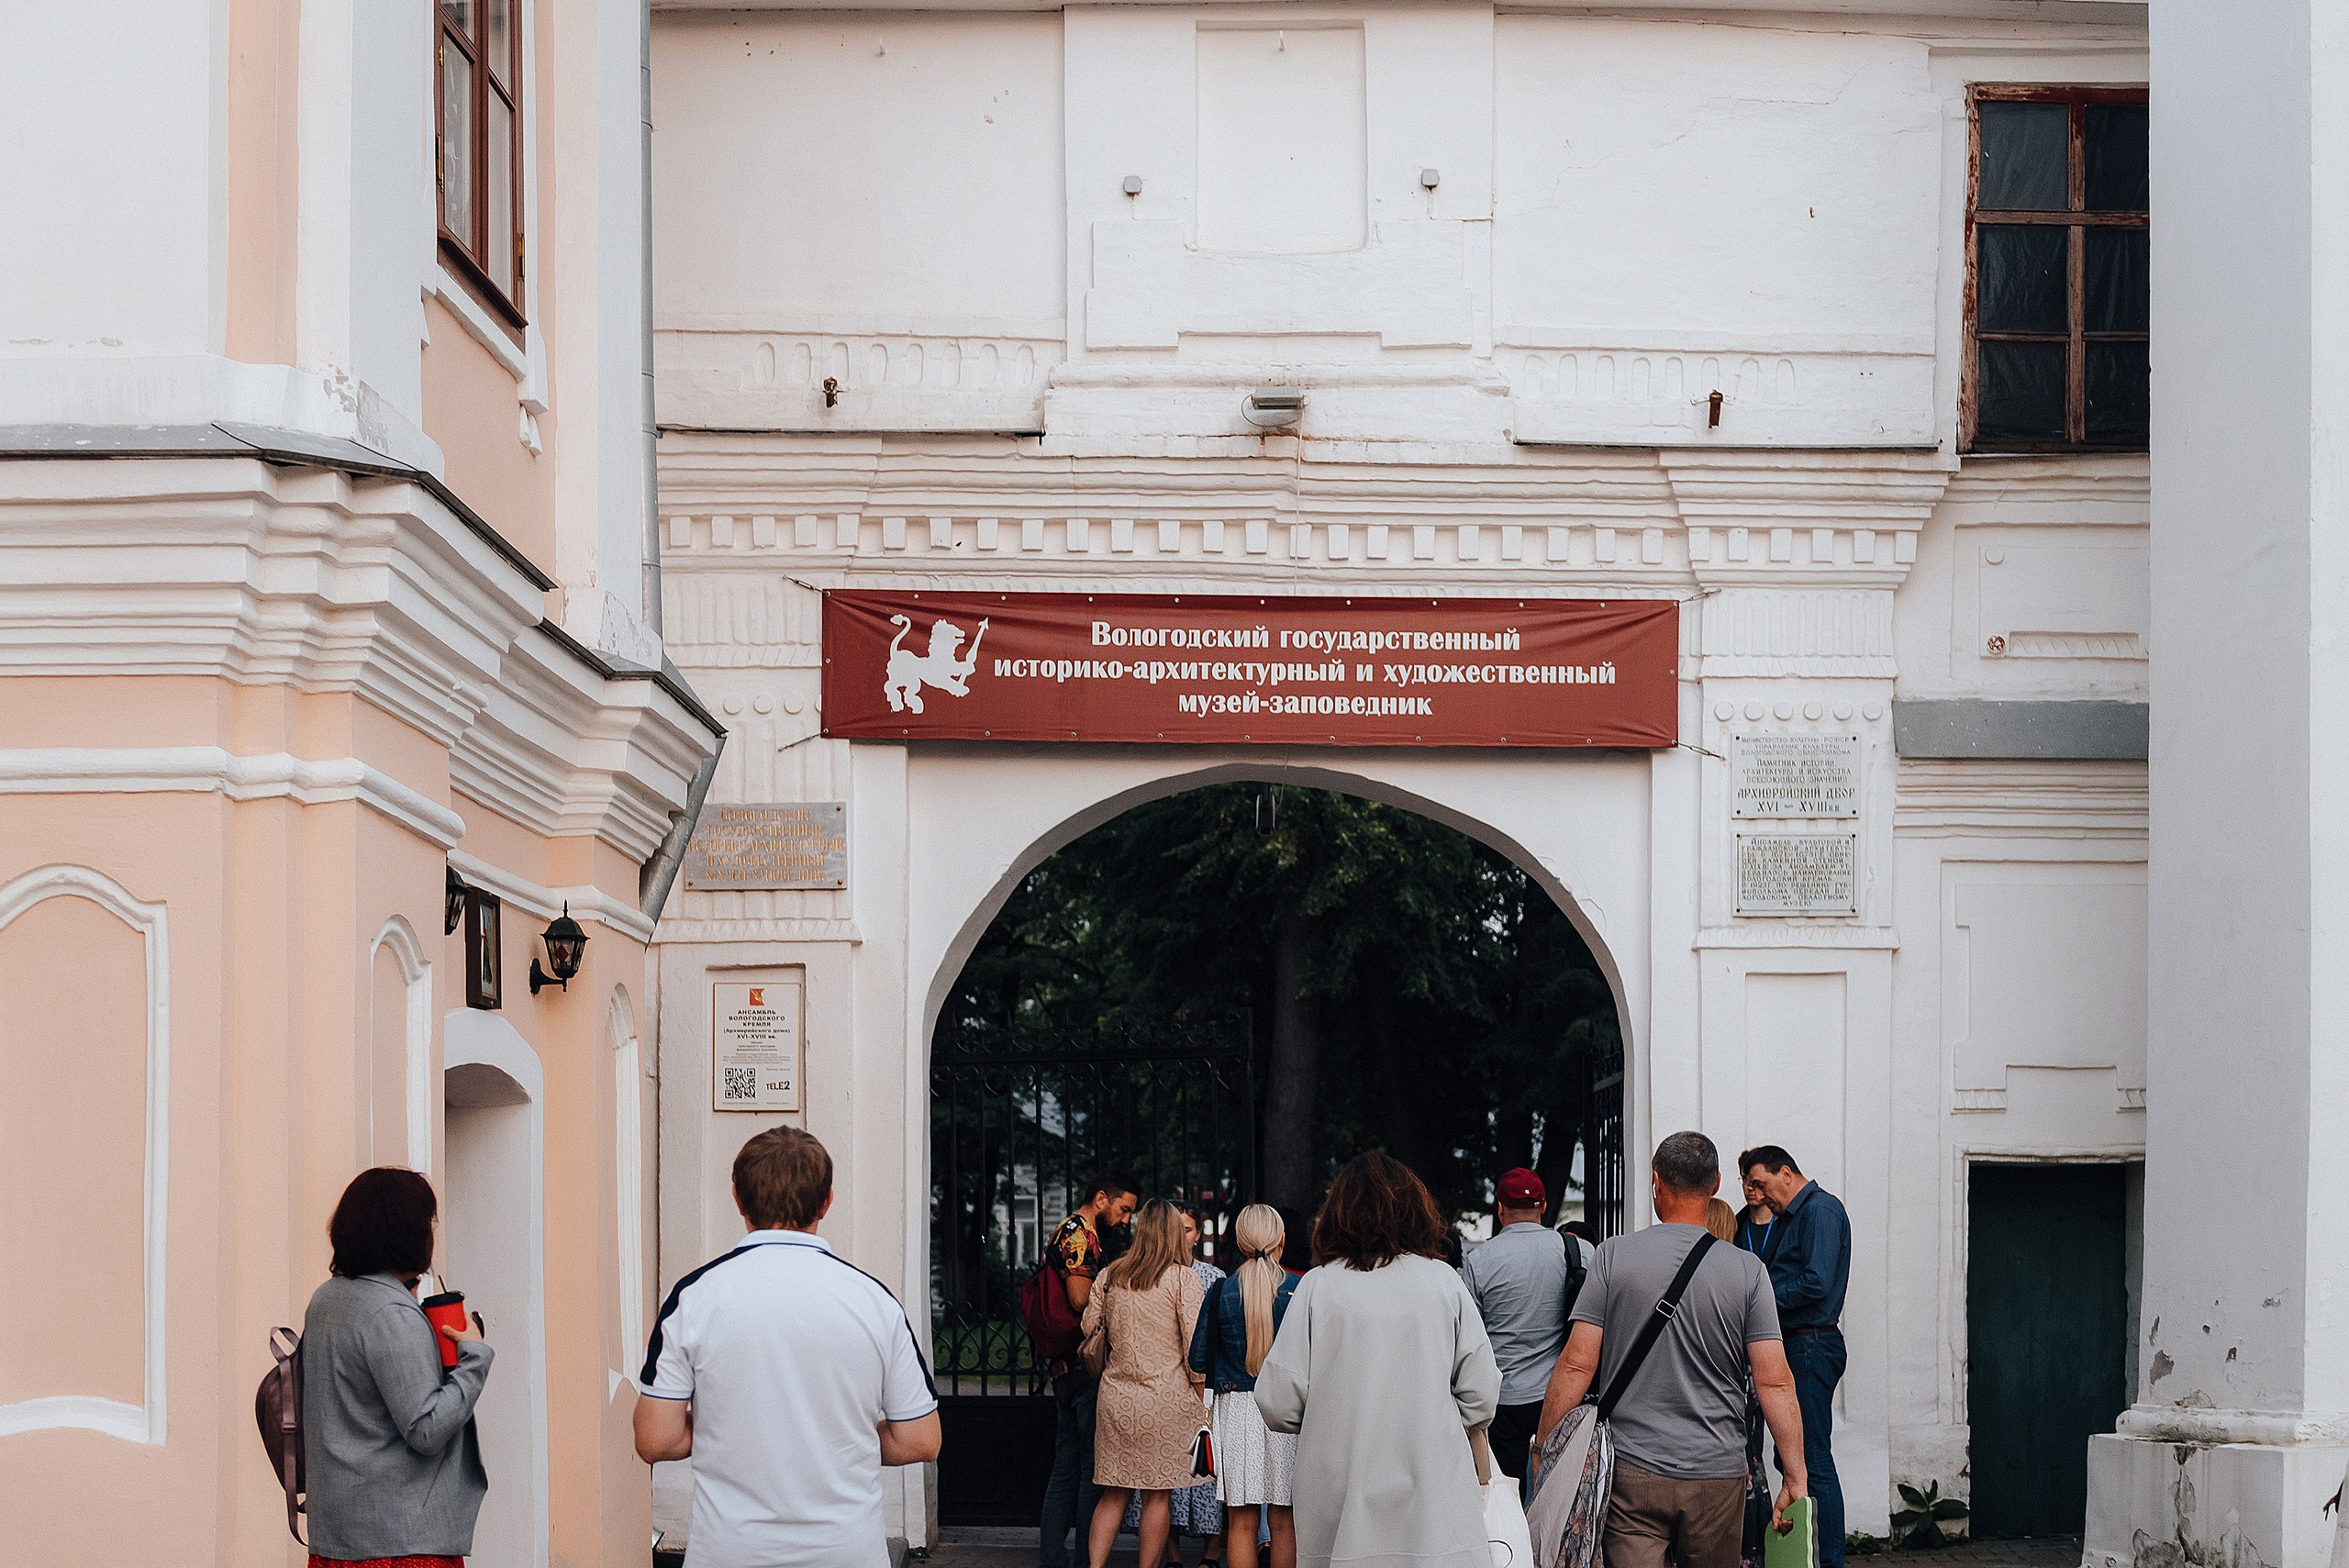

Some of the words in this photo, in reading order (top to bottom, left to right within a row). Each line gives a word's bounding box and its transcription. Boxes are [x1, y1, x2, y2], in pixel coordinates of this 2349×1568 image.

[1091, 621, 1270, 650] Вологодский
[1280, 627, 1520, 654] государственный
[994, 658, 1345, 686] историко-архитектурный
[1356, 664, 1373, 682] и
[1384, 661, 1616, 688] художественный
[1179, 690, 1433, 718] музей-заповедник
[766, 1081, 790, 1090] TELE2
